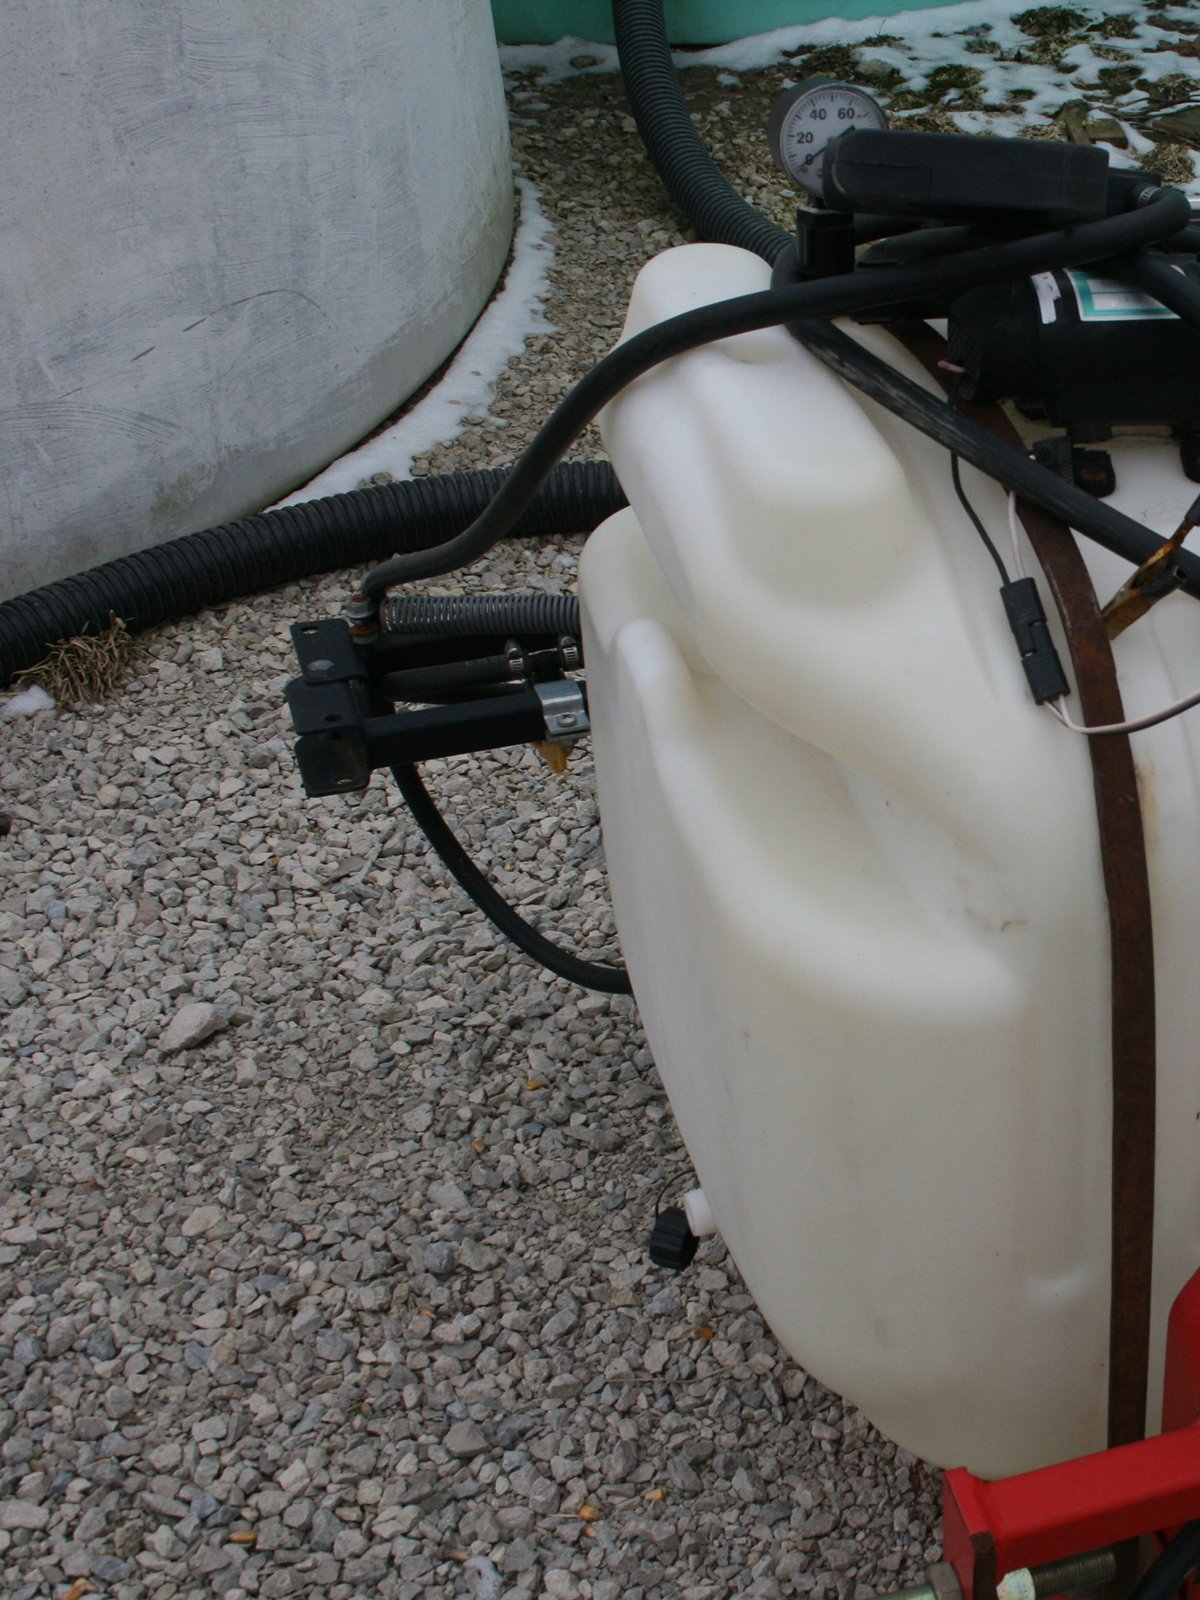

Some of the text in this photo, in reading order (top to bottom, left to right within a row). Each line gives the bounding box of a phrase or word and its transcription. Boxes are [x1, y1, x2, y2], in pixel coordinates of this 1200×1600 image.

[810, 108, 827, 120] 40
[838, 108, 855, 120] 60
[797, 131, 814, 144] 20
[805, 153, 814, 165] 0
